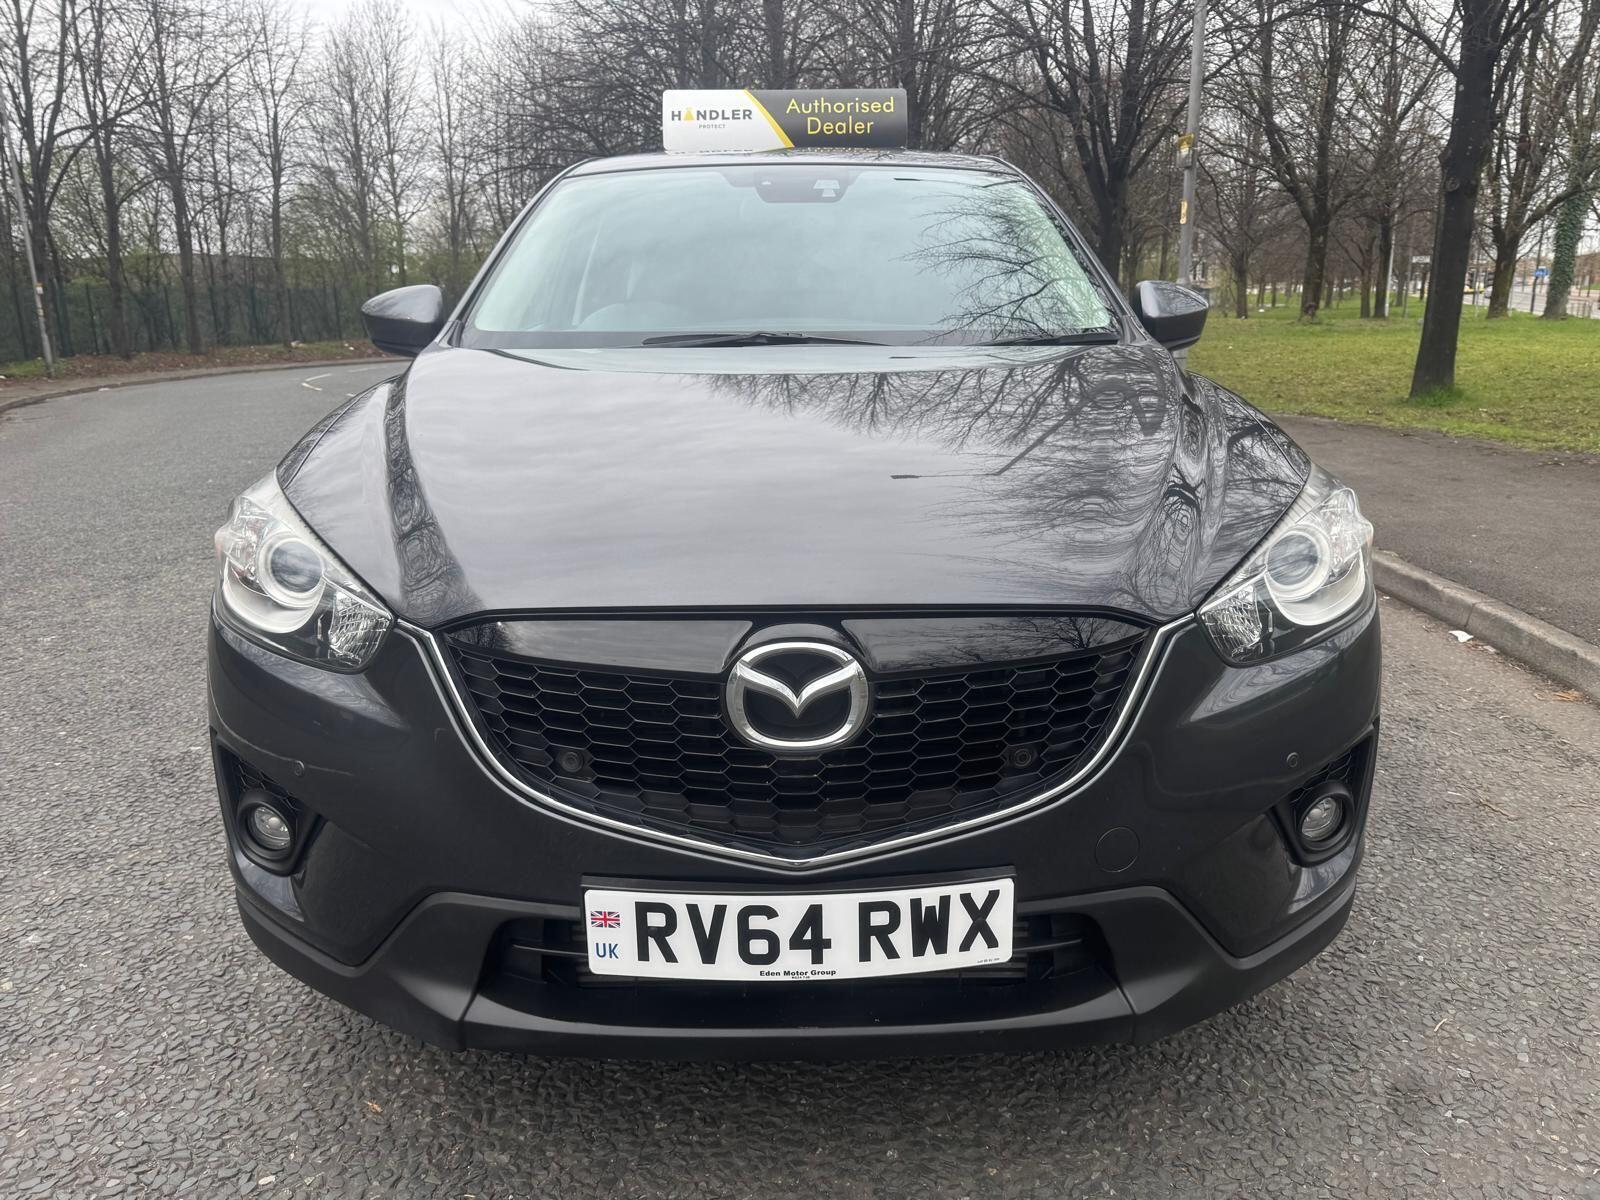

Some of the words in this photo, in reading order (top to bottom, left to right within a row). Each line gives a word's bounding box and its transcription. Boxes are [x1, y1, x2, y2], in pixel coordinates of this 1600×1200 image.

[671, 106, 753, 121] HANDLER
[786, 96, 894, 114] Authorised
[807, 116, 874, 135] Dealer
[634, 901, 832, 966] RV64
[858, 889, 1000, 963] RWX
[595, 942, 619, 960] UK
